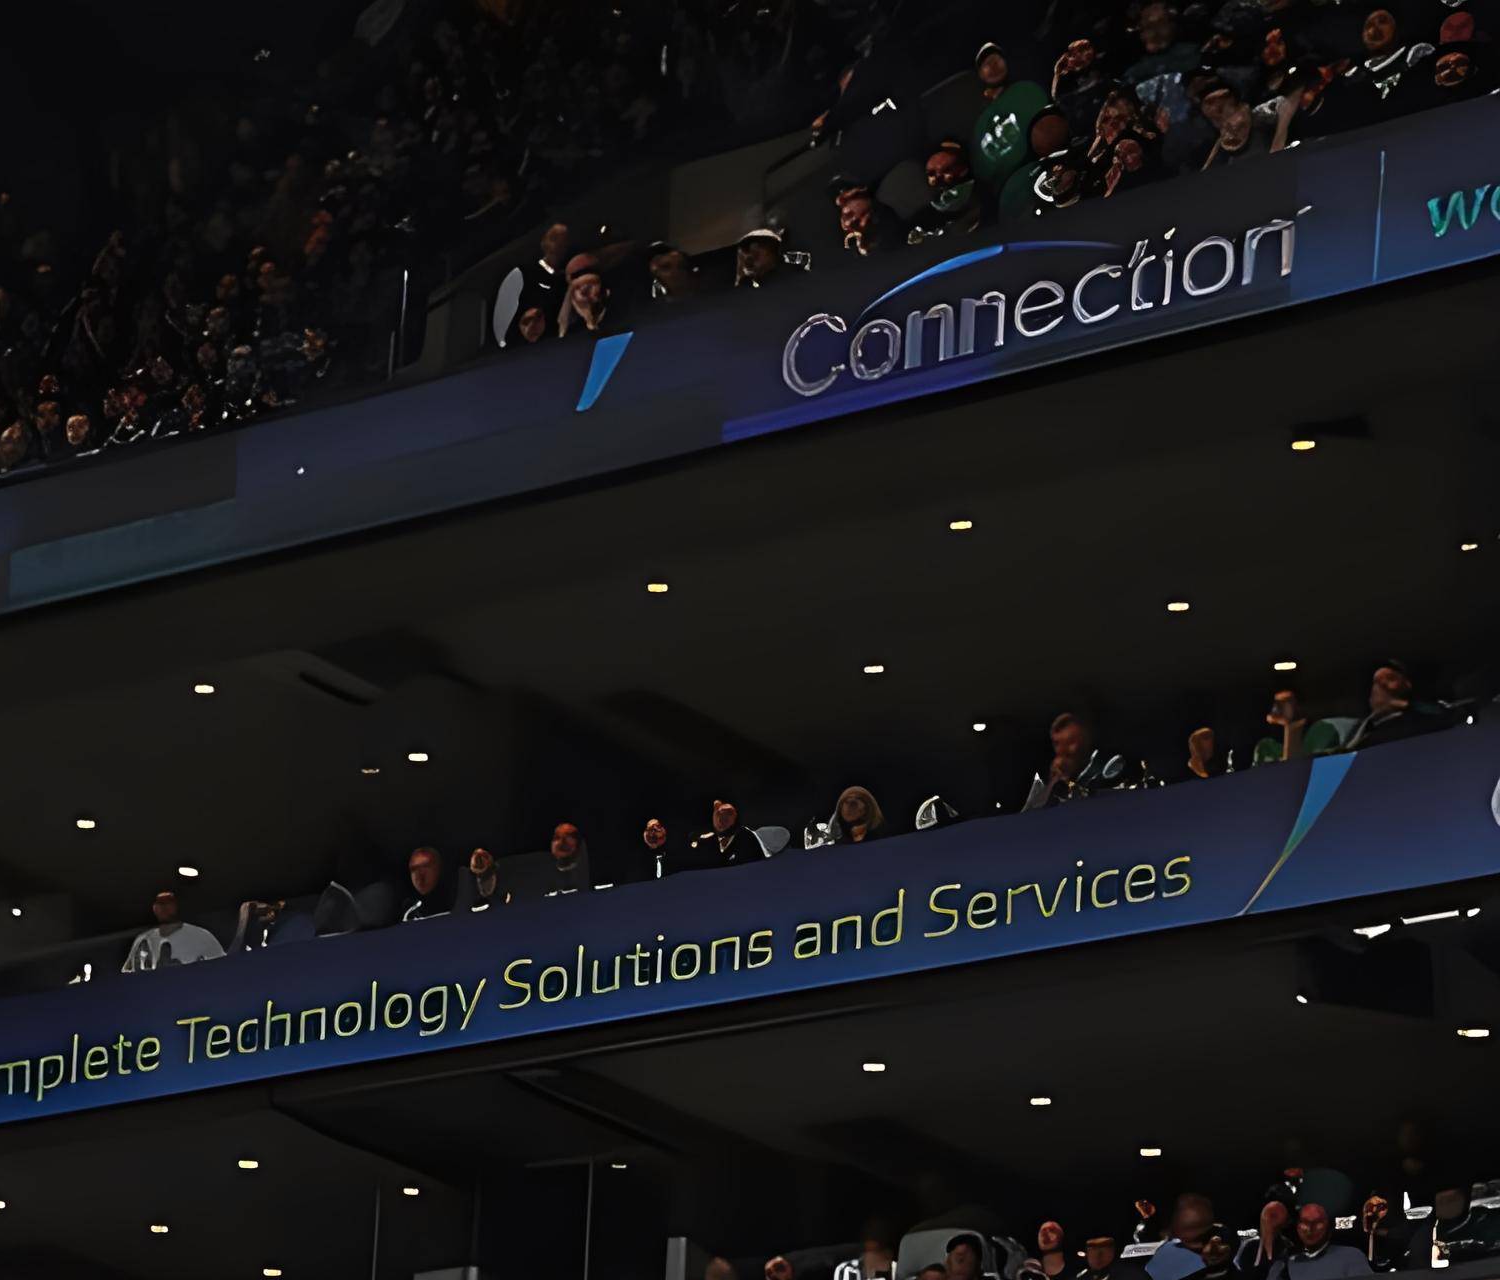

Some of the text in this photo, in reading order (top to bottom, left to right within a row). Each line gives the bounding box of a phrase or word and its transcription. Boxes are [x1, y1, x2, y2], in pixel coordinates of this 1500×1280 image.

[1426, 184, 1500, 237] w
[781, 217, 1297, 397] Connection
[177, 977, 487, 1063] Technology
[498, 930, 773, 1010] Solutions
[793, 888, 905, 960] and
[924, 856, 1191, 939] Services
